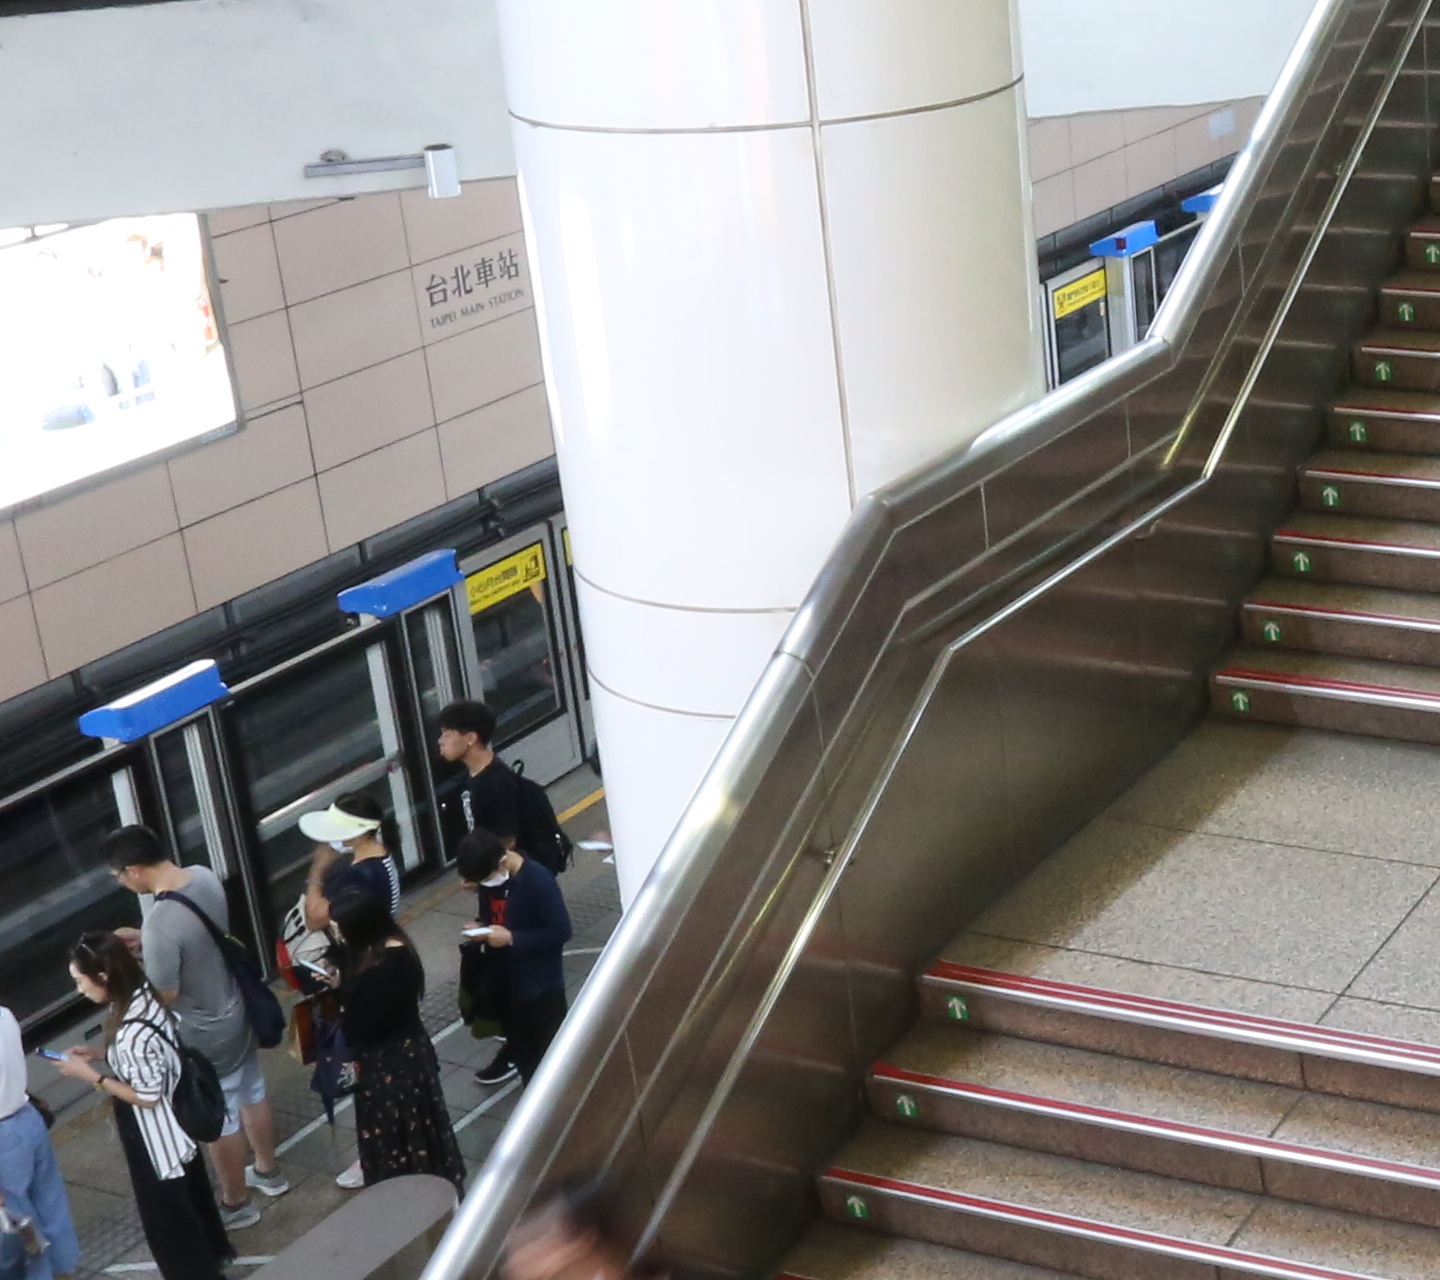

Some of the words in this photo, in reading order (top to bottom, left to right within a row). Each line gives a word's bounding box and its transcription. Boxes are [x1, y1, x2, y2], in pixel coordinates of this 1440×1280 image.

[425, 248, 519, 307] 台北車站
[430, 312, 457, 328] TAIPEI
[461, 302, 485, 316] MAIN
[488, 288, 524, 307] STATION
